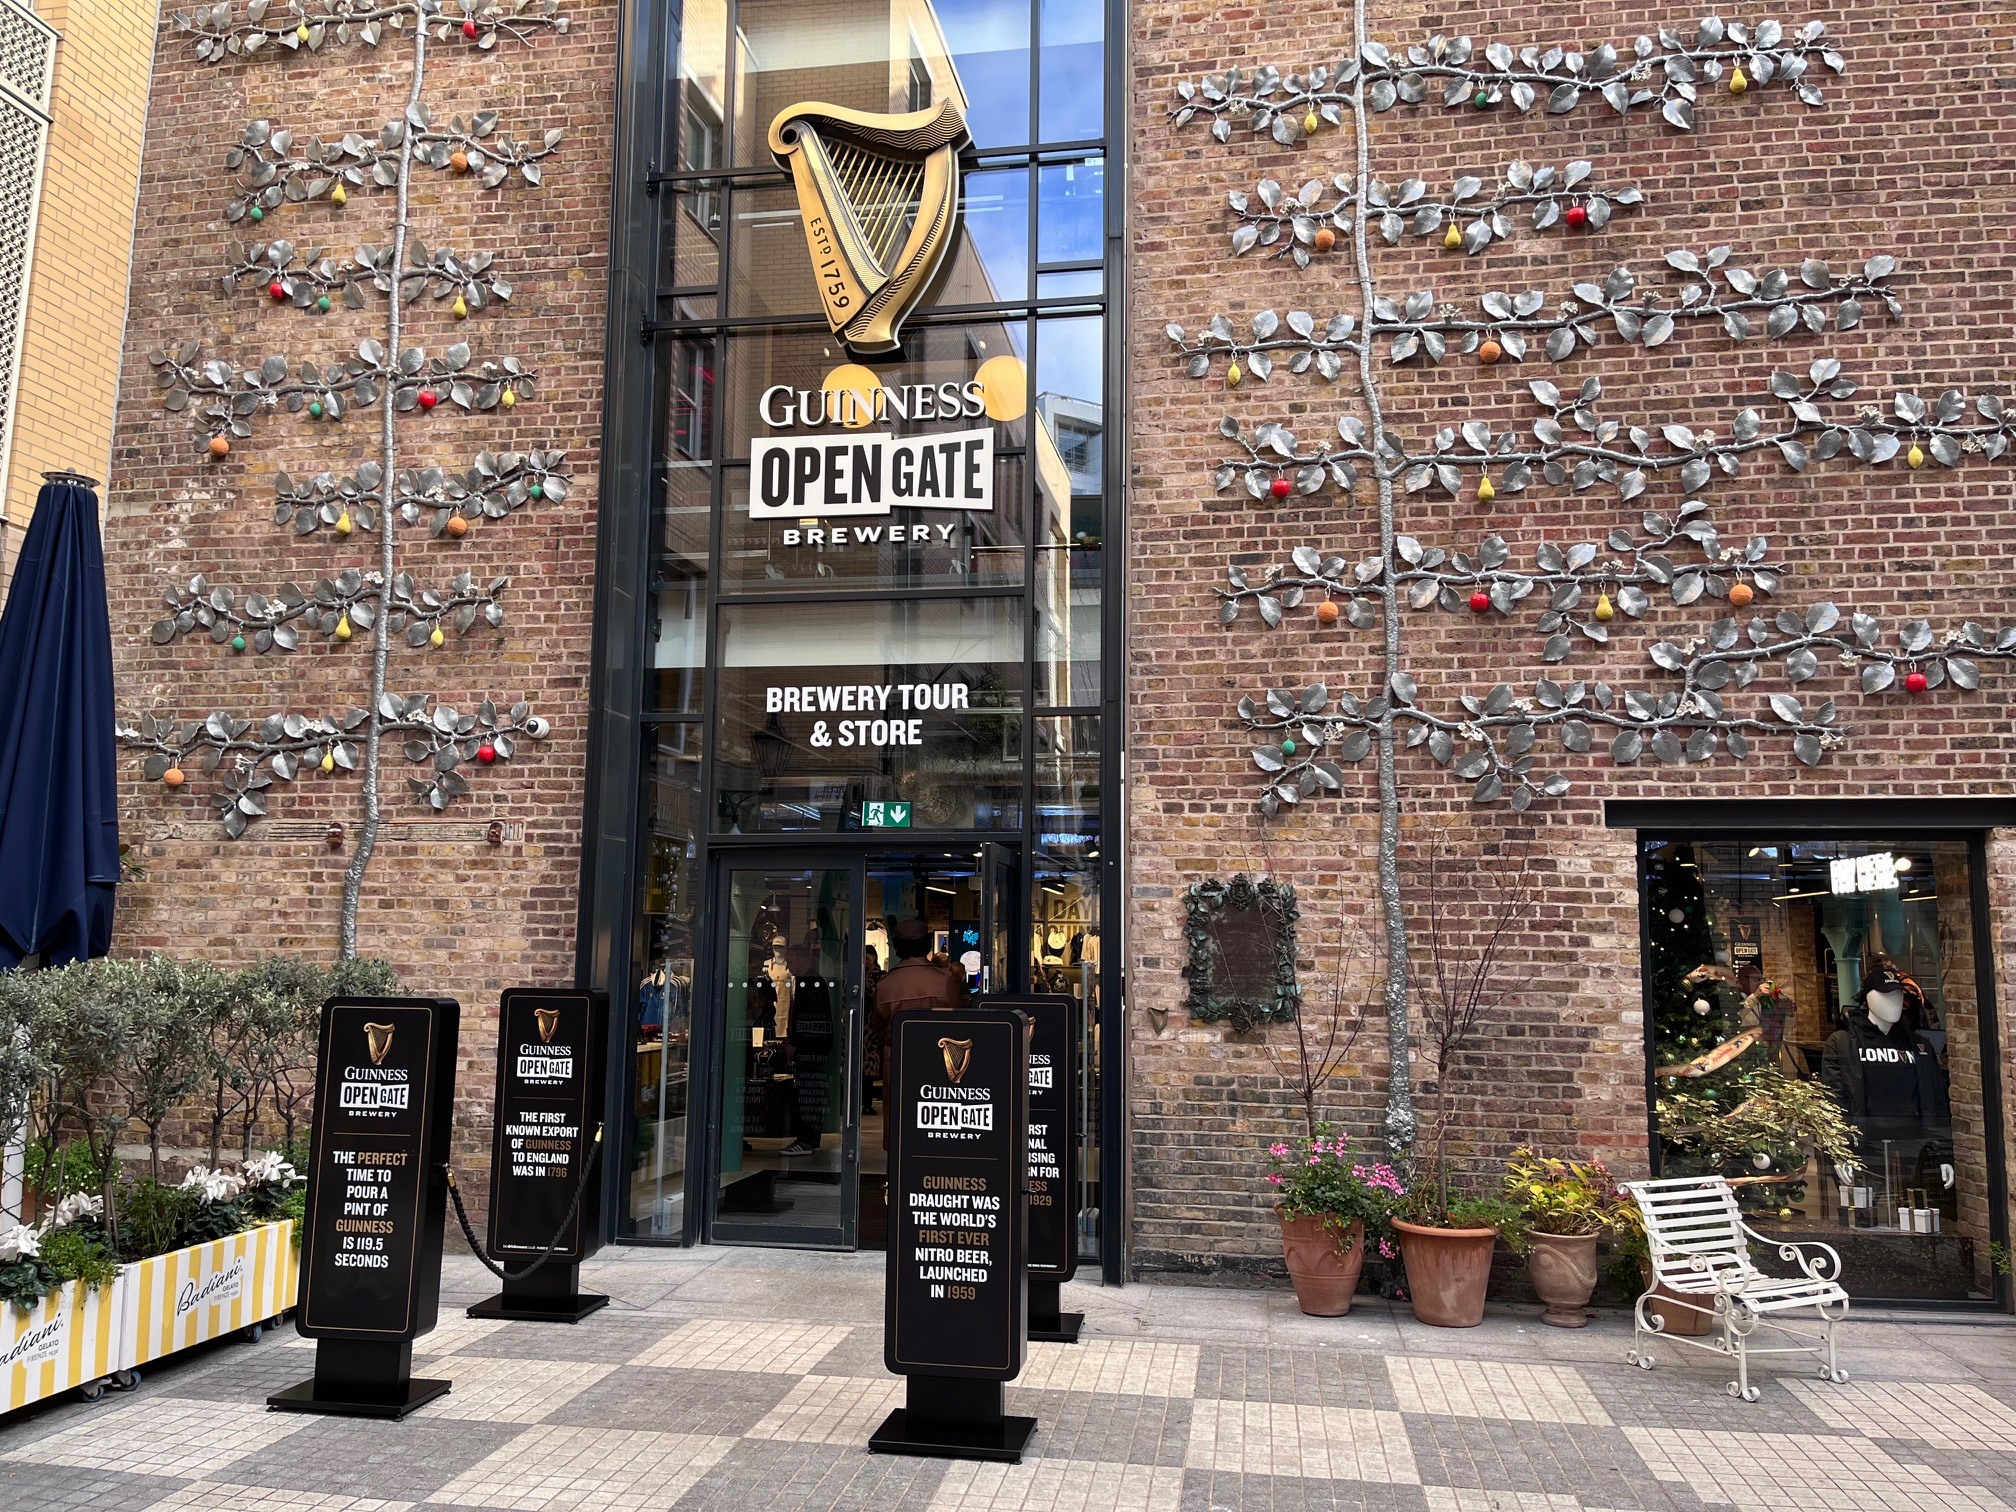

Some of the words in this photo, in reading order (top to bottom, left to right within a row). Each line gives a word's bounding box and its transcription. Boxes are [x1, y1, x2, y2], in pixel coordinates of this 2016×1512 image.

[820, 259, 850, 308] 1759
[759, 380, 986, 428] GUINNESS
[760, 444, 882, 507] OPEN
[892, 438, 984, 499] GATE
[783, 523, 955, 546] BREWERY
[766, 685, 892, 713] BREWERY
[897, 683, 970, 710] TOUR
[809, 720, 833, 747] &
[837, 719, 923, 746] STORE
[1054, 899, 1093, 919] DAY
[520, 1043, 572, 1056] GUINNESS
[344, 1066, 408, 1081] GUINNESS
[520, 1059, 548, 1075] OPEN
[550, 1060, 570, 1076] GATE
[343, 1086, 379, 1105] OPEN
[380, 1087, 407, 1106] GATE
[920, 1084, 991, 1101] GUINNESS
[349, 1110, 397, 1118] BREWERY
[520, 1112, 538, 1123] THE
[540, 1113, 566, 1124] FIRST
[921, 1105, 959, 1126] OPEN
[961, 1106, 990, 1127] GATE
[506, 1125, 541, 1136] KNOWN
[542, 1126, 579, 1138] EXPORT
[928, 1132, 981, 1140] BREWERY
[511, 1138, 524, 1149] OF
[525, 1139, 572, 1151] GUINNESS
[333, 1151, 356, 1164] THE
[357, 1152, 408, 1166] PERFECT
[512, 1152, 525, 1163] TO
[527, 1152, 569, 1164] ENGLAND
[346, 1168, 374, 1182] TIME
[376, 1169, 391, 1183] TO
[512, 1165, 534, 1177] WAS
[535, 1166, 546, 1177] IN
[547, 1166, 567, 1178] 1796
[1040, 1166, 1060, 1178] FOR
[922, 1175, 987, 1191] GUINNESS
[346, 1185, 379, 1199] POUR
[380, 1186, 388, 1199] A
[909, 1193, 969, 1210] DRAUGHT
[970, 1195, 1000, 1211] WAS
[1029, 1194, 1052, 1206] 1929
[344, 1202, 371, 1216] PINT
[373, 1203, 388, 1216] OF
[335, 1219, 394, 1234] GUINNESS
[912, 1211, 937, 1226] THE
[940, 1212, 997, 1228] WORLD'S
[343, 1236, 354, 1249] IS
[356, 1237, 383, 1250] 119.5
[919, 1229, 954, 1244] FIRST
[957, 1231, 990, 1246] EVER
[334, 1253, 389, 1268] SECONDS
[915, 1247, 954, 1263] NITRO
[956, 1249, 993, 1266] BEER,
[919, 1265, 988, 1283] LAUNCHED
[177, 1259, 242, 1316] Badiani
[222, 1281, 240, 1292] GELATO
[930, 1284, 944, 1298] IN
[947, 1285, 976, 1300] 1959
[38, 1339, 60, 1351] GELATO
